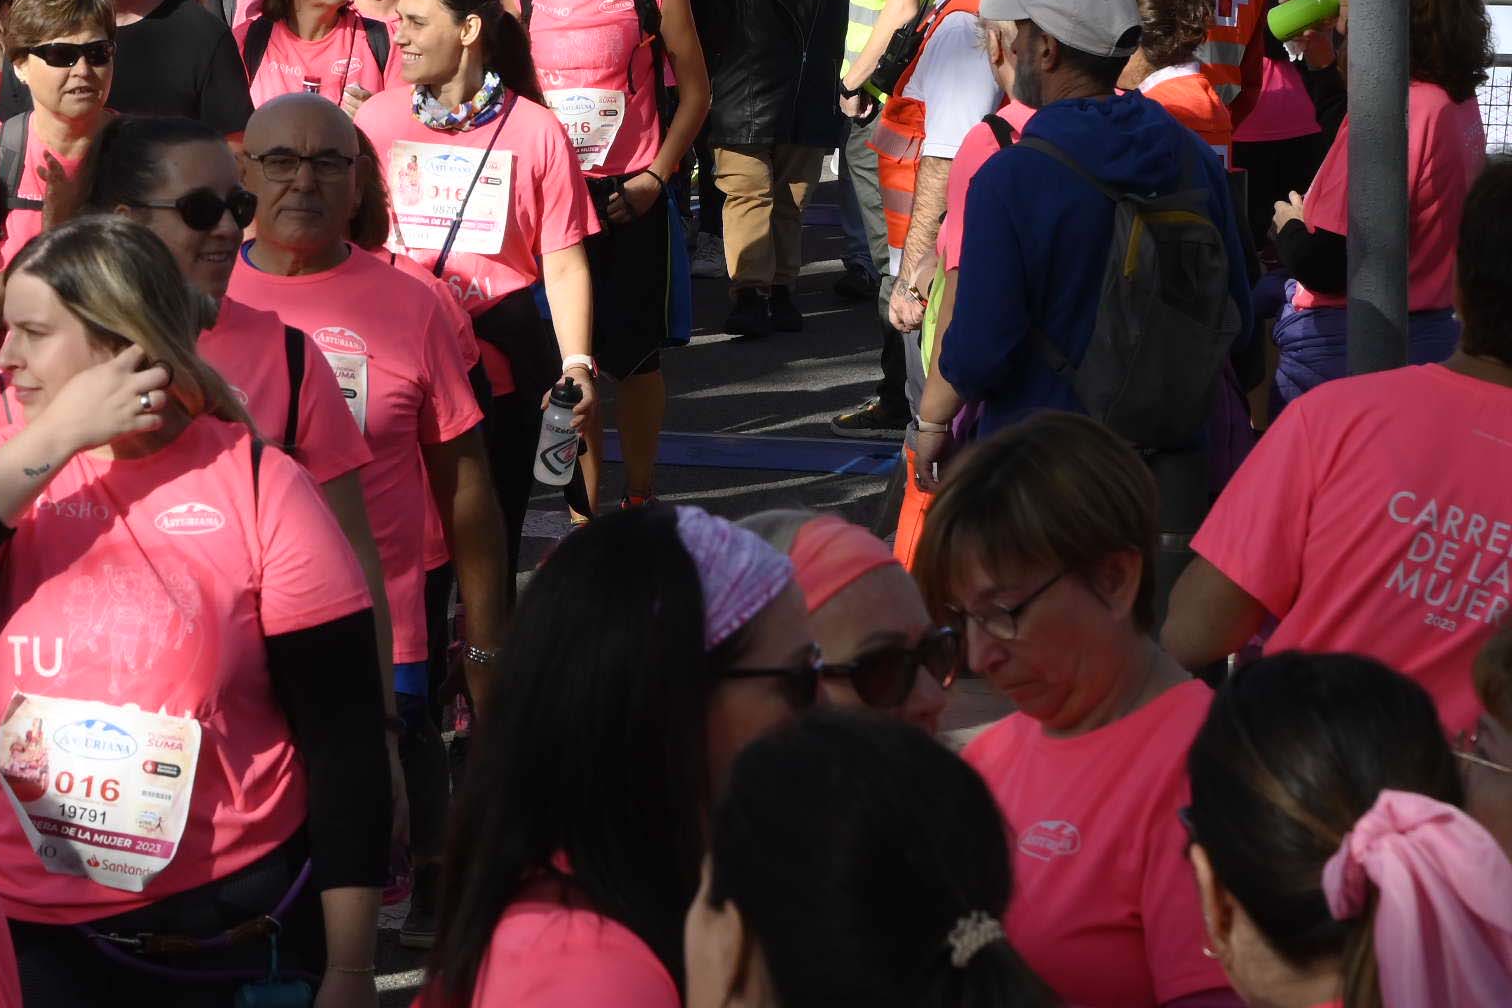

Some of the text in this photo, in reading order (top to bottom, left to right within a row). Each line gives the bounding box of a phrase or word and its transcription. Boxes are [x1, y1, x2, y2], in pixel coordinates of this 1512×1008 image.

[161, 515, 221, 529] ASTURIANA
[1407, 530, 1510, 594] DE LA
[1385, 560, 1509, 626] MUJER
[1424, 612, 1457, 633] 2023
[8, 634, 63, 677] TU
[146, 739, 184, 752] SUMA
[54, 771, 120, 802] 016
[58, 803, 107, 825] 19791
[61, 826, 161, 854] DE LA MUJER 2023
